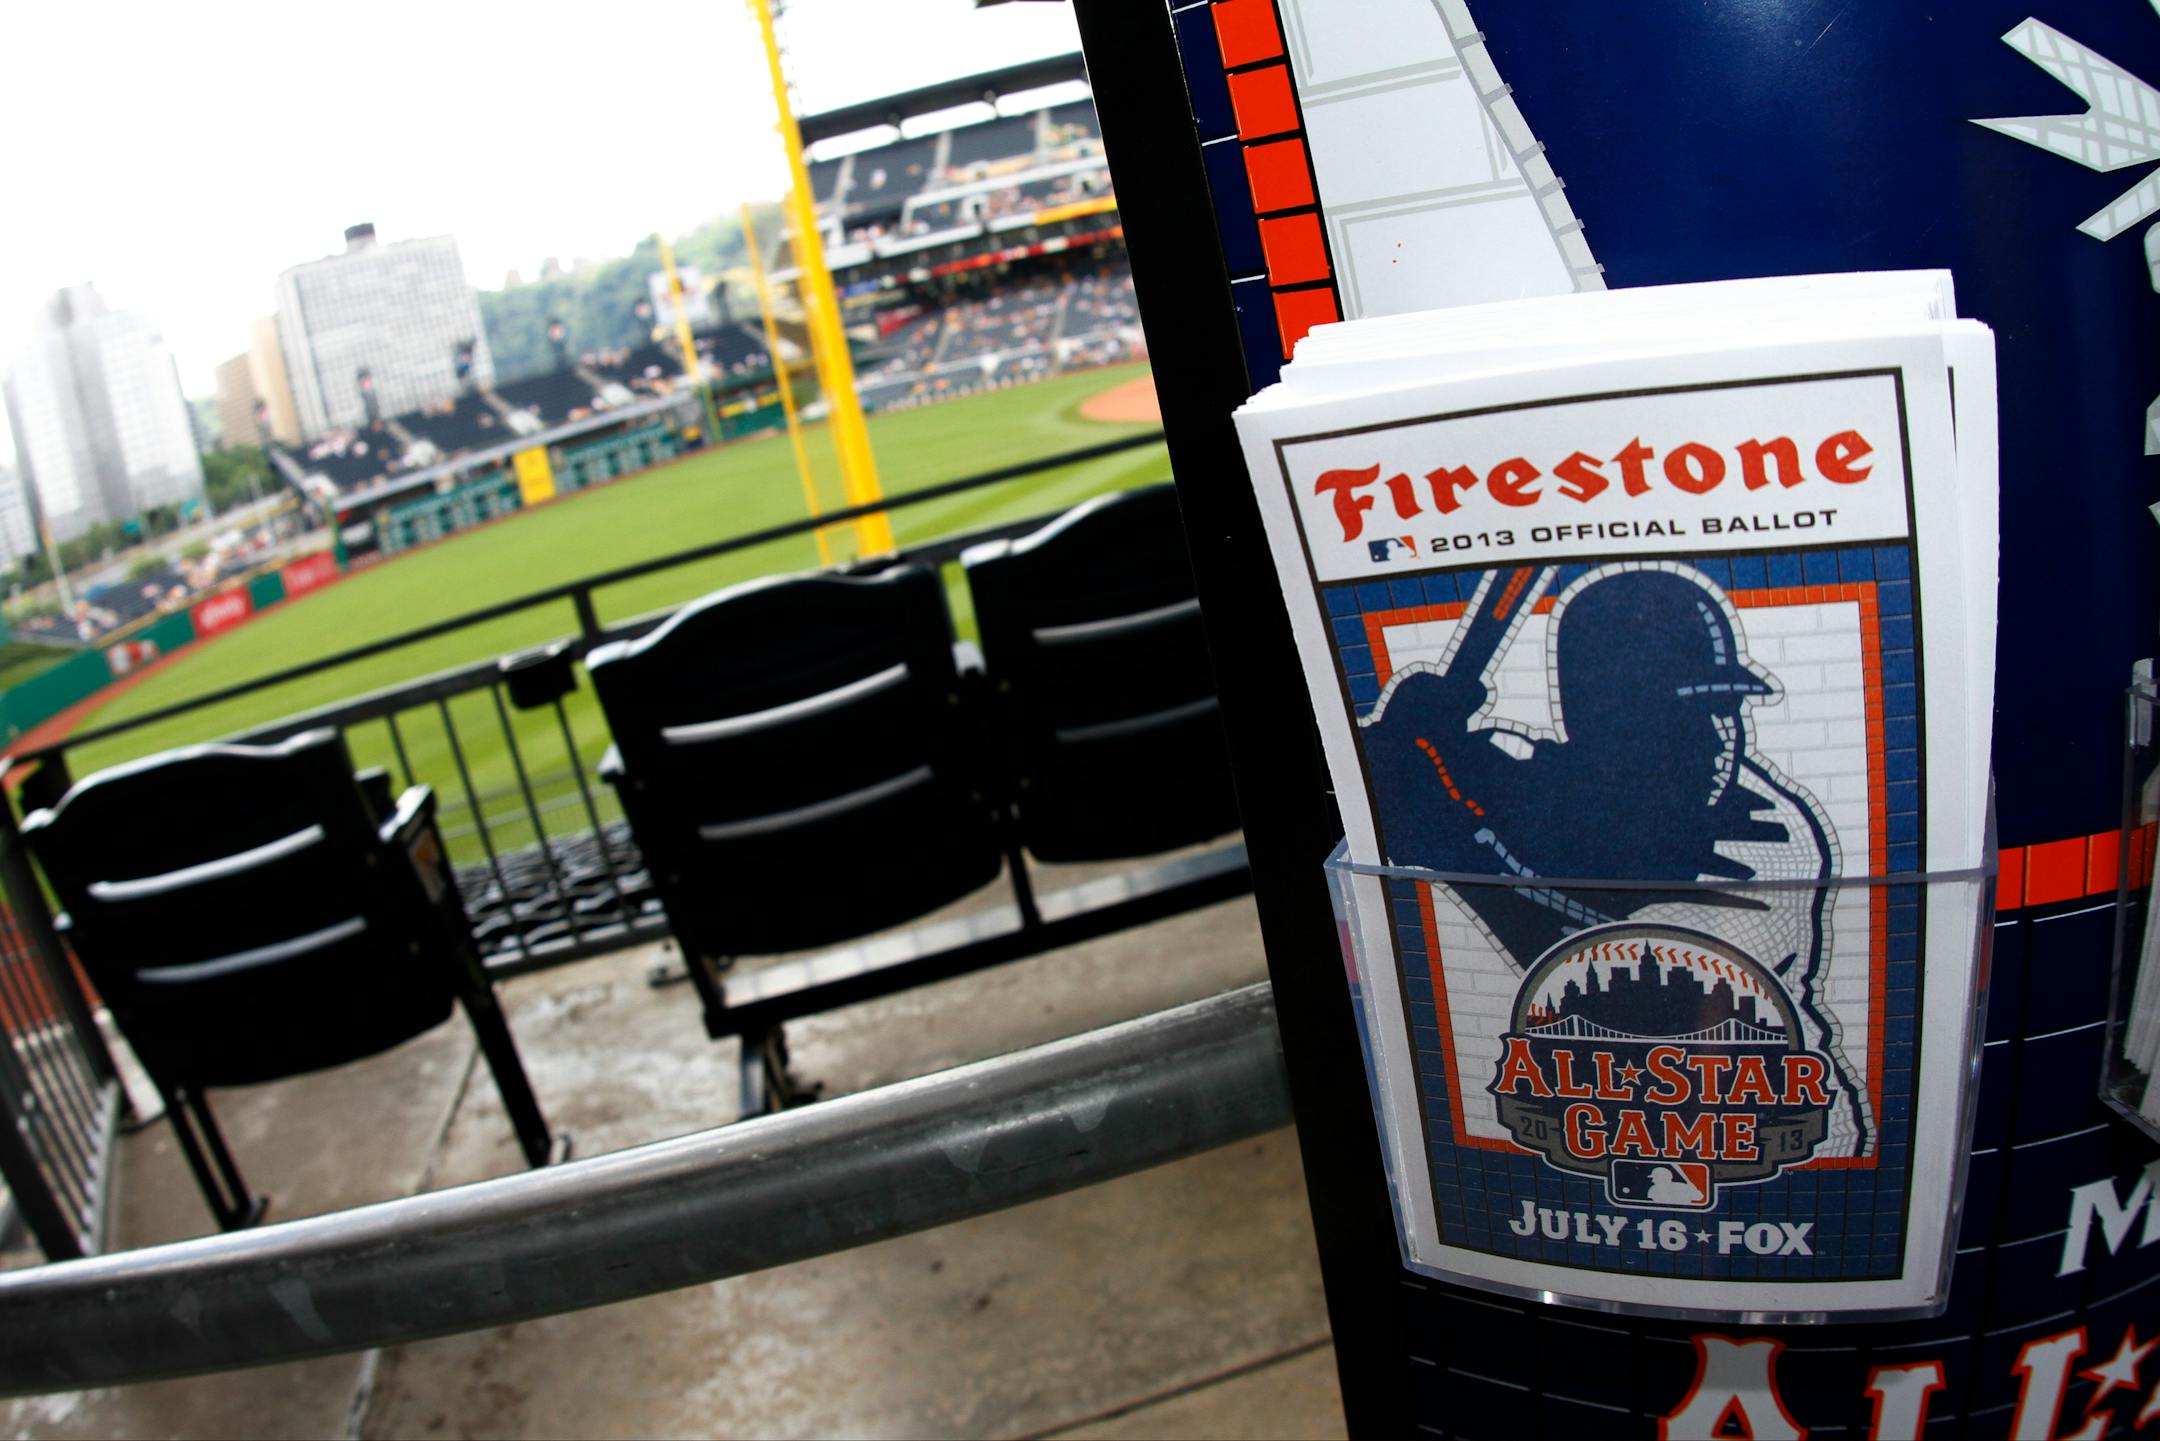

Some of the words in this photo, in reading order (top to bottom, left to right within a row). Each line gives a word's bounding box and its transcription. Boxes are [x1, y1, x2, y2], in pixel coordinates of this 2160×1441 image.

[1314, 428, 1875, 543] Firestone
[1430, 530, 1515, 553] 2013
[1531, 519, 1686, 543] OFFICIAL
[1701, 508, 1838, 534] BALLOT
[1494, 1036, 1632, 1101] ALL
[1643, 1044, 1832, 1107] STAR
[1519, 1115, 1548, 1142] 20
[1562, 1102, 1760, 1162] GAME
[1779, 1127, 1803, 1153] 13
[1507, 1200, 1629, 1248] JULY
[1637, 1218, 1688, 1252] 16
[1717, 1220, 1814, 1256] FOX
